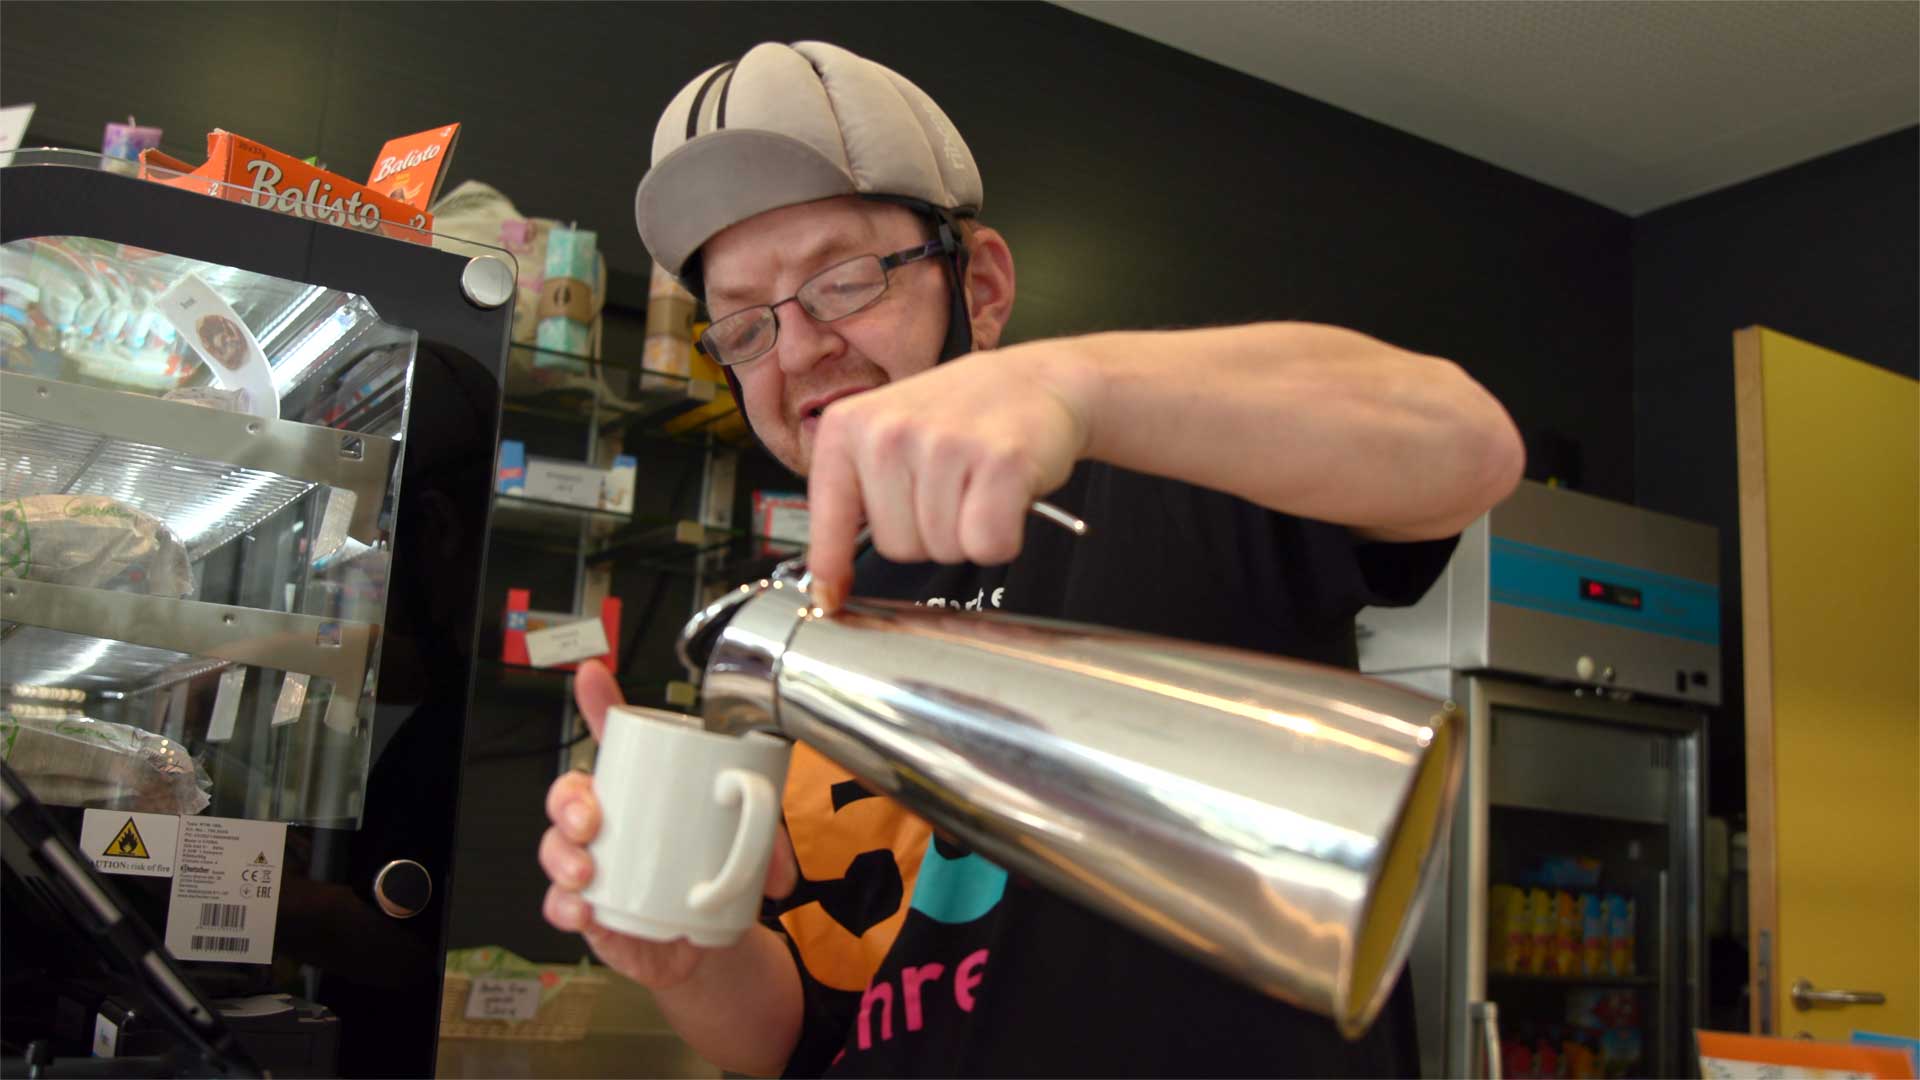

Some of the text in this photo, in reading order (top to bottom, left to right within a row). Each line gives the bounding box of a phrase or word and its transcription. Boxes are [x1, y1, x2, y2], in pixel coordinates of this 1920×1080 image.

[373, 144, 441, 184] Balisto
[240, 158, 382, 231] Balisto
[130, 862, 145, 872] risk
[147, 863, 157, 873] of
[157, 863, 171, 874] fire
